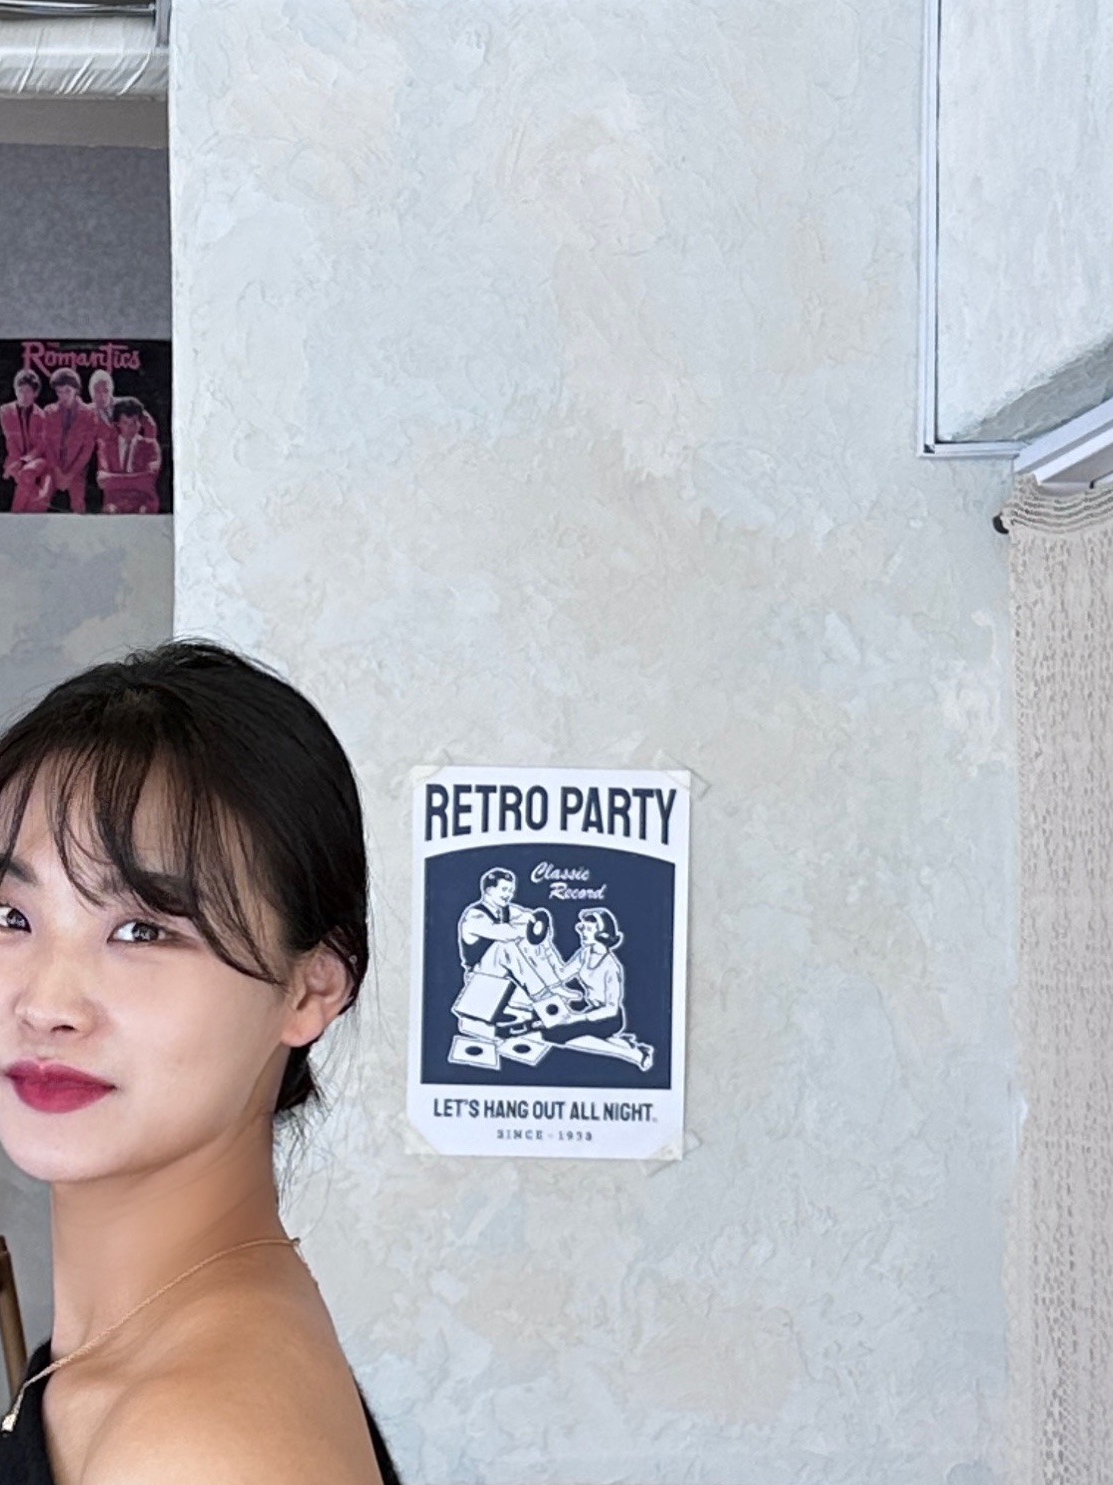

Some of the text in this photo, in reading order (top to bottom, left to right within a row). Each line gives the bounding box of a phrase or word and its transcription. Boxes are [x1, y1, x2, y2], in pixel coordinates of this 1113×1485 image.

[20, 341, 141, 378] Romantics
[425, 783, 677, 845] RETRO PARTY
[531, 861, 591, 883] Classic
[549, 882, 608, 900] Record
[433, 1098, 480, 1118] LET'S
[484, 1099, 529, 1119] HANG
[532, 1101, 566, 1120] OUT
[570, 1102, 600, 1121] ALL
[496, 1129, 543, 1141] SINCE
